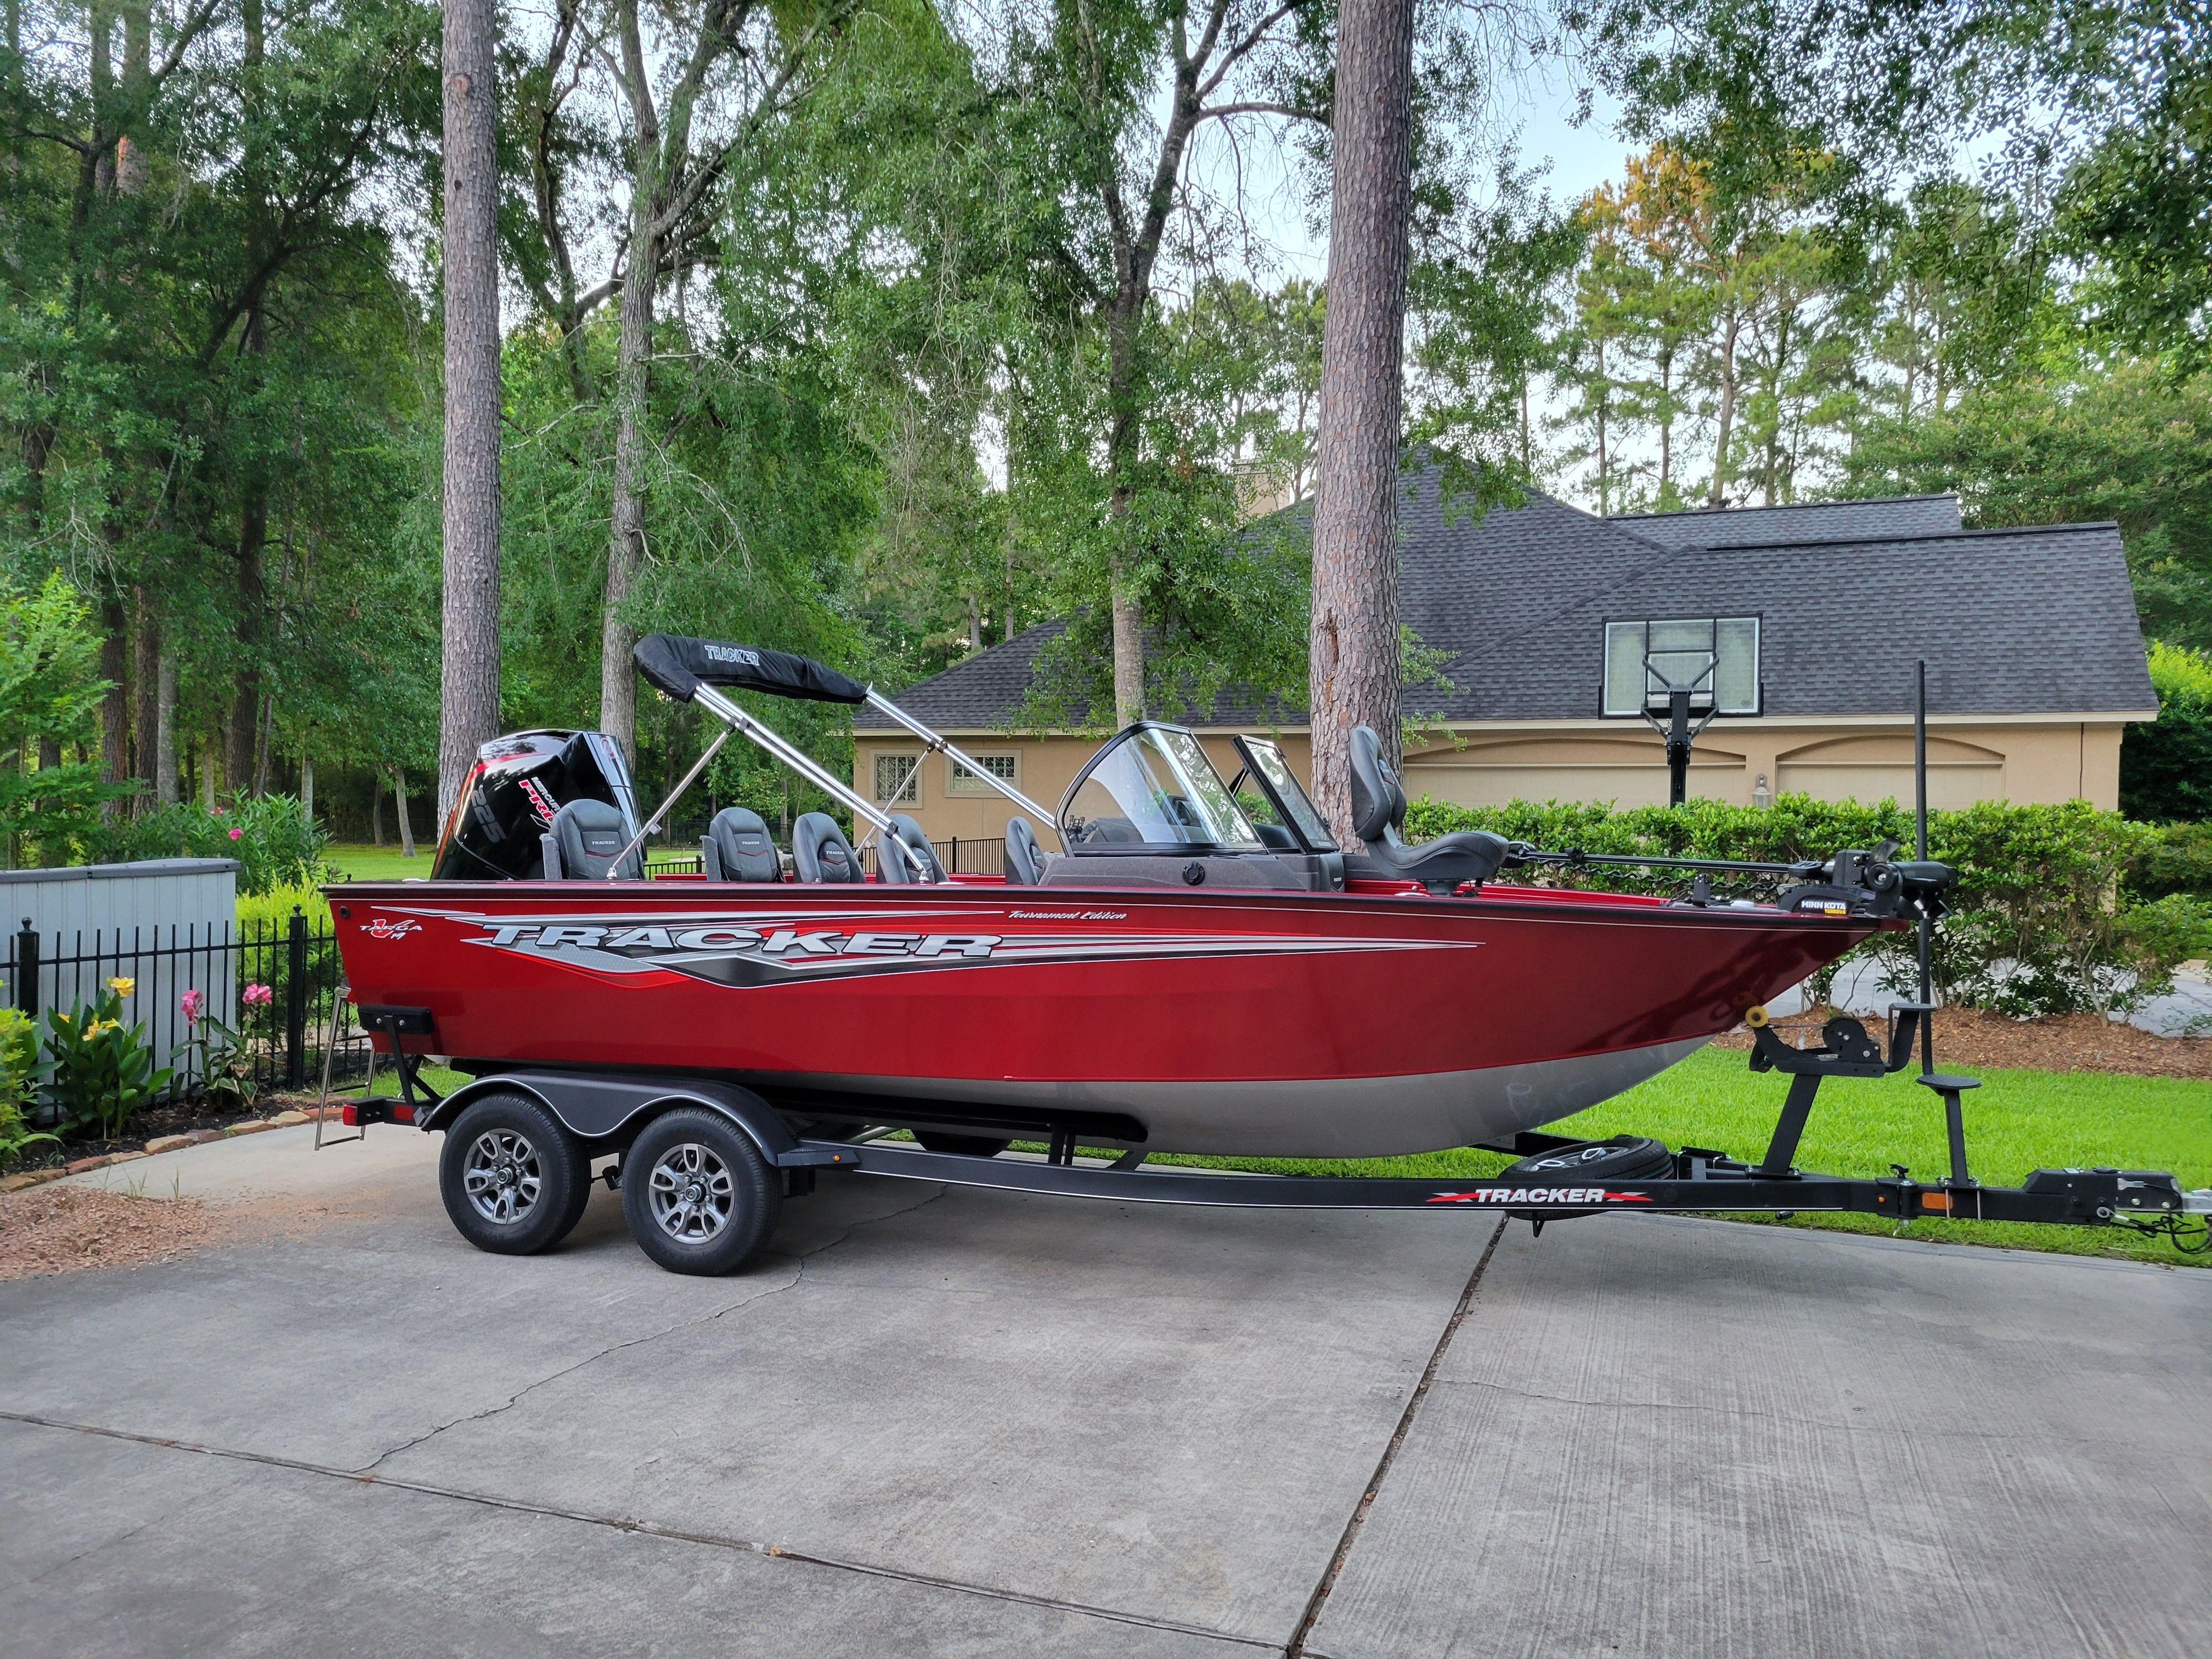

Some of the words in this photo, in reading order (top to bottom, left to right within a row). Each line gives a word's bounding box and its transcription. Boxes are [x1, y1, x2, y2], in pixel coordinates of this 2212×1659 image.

[704, 645, 760, 667] TRACKER
[531, 776, 561, 814] MERCUR
[471, 784, 507, 843] 225
[1008, 910, 1081, 920] Tournament
[1079, 910, 1127, 920] Edition
[1801, 900, 1823, 909] MINN
[482, 924, 1003, 957] TRACKER
[1475, 1188, 1606, 1203] TRACKER
